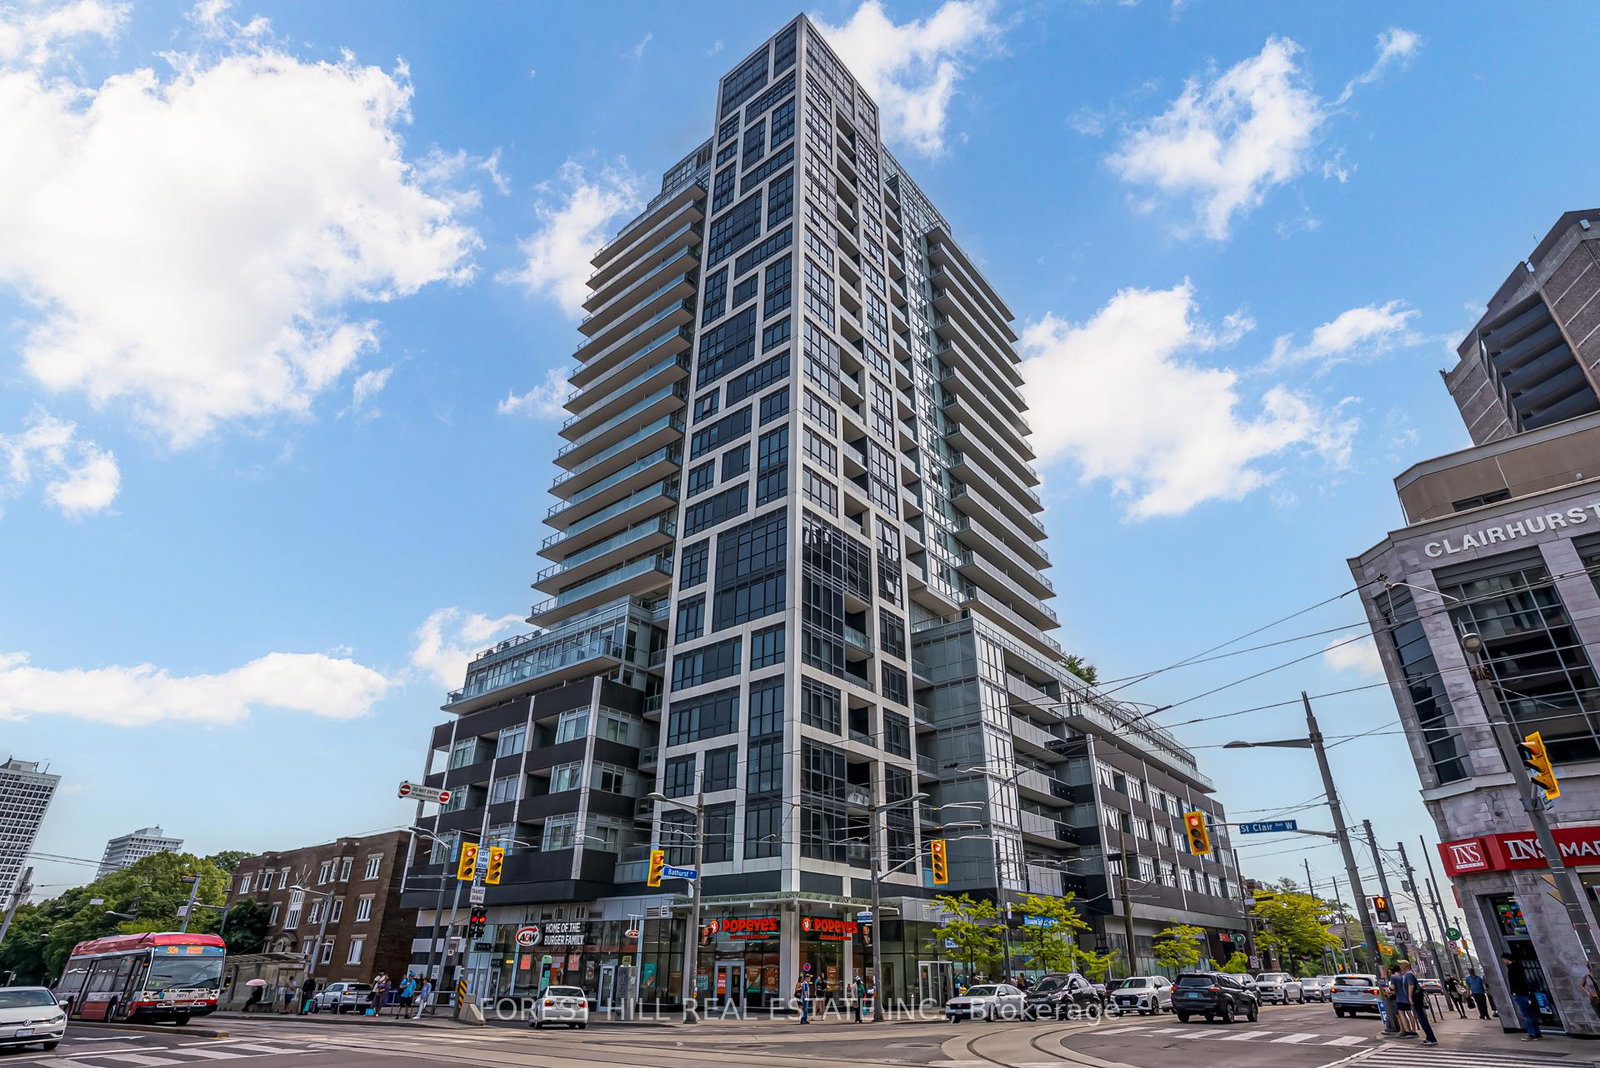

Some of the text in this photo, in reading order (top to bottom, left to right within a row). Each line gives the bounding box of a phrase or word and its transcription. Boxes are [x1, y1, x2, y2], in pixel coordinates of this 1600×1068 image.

[1240, 824, 1250, 833] St
[1252, 822, 1273, 832] Clair
[1285, 821, 1293, 830] W
[1450, 842, 1481, 865] INS
[667, 868, 689, 878] Bathurst
[545, 922, 580, 933] HOME OF THE
[544, 934, 565, 945] BURGER
[1396, 931, 1409, 941] 40
